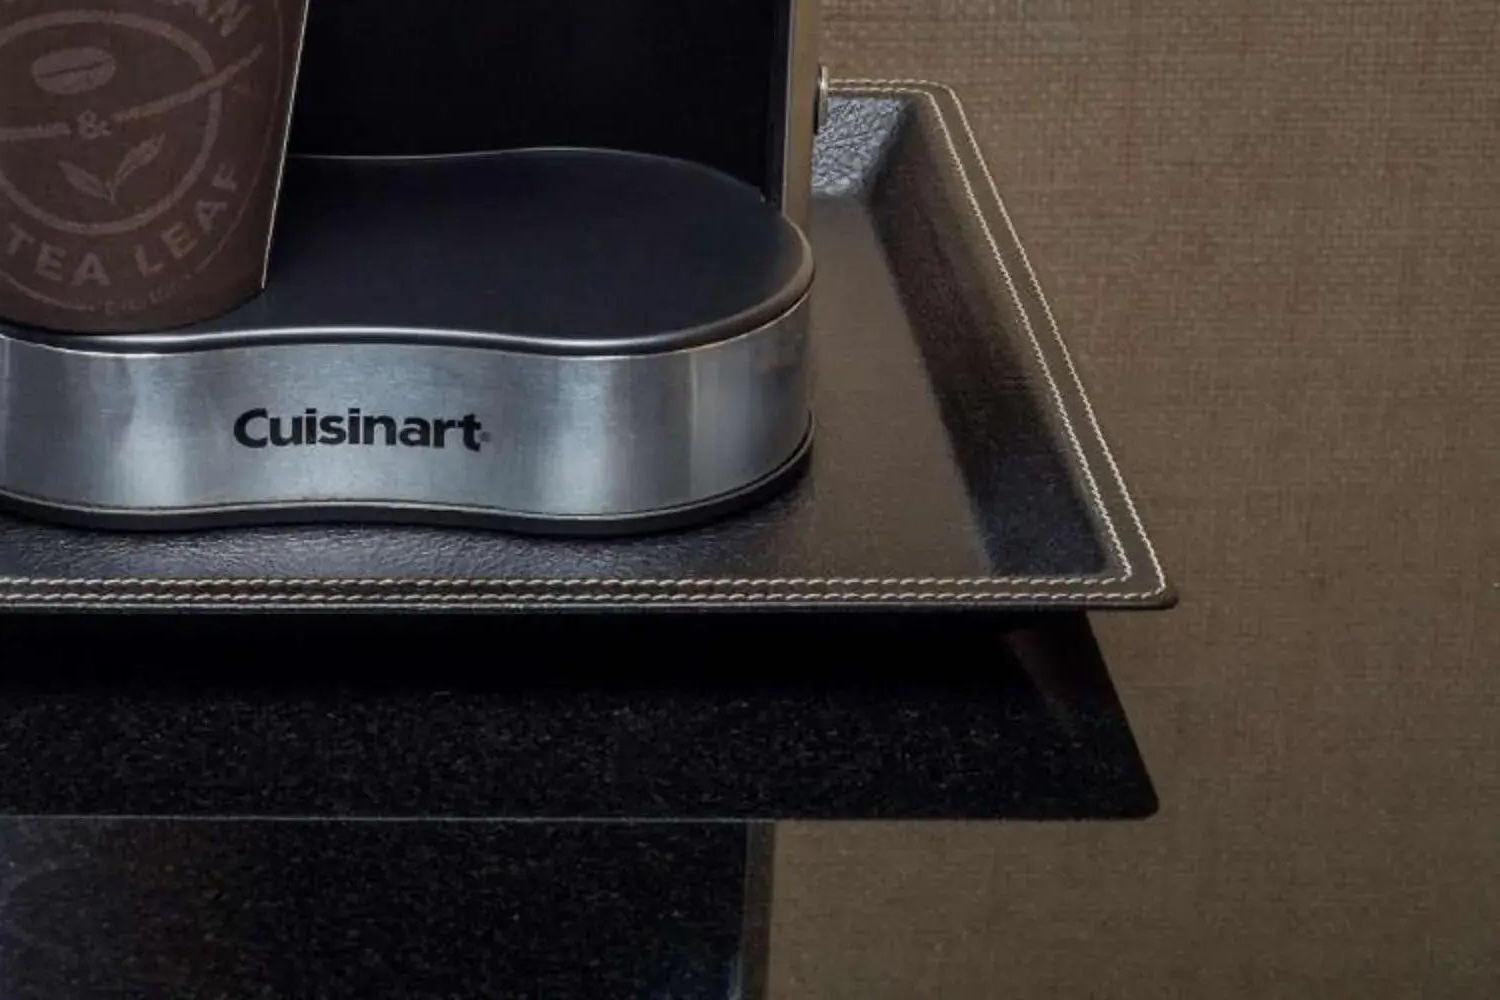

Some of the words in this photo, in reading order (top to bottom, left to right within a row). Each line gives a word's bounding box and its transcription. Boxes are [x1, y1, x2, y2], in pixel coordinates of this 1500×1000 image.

[77, 109, 112, 140] &
[5, 223, 110, 287] TEA
[134, 162, 241, 276] LEAF
[233, 408, 482, 453] Cuisinart
